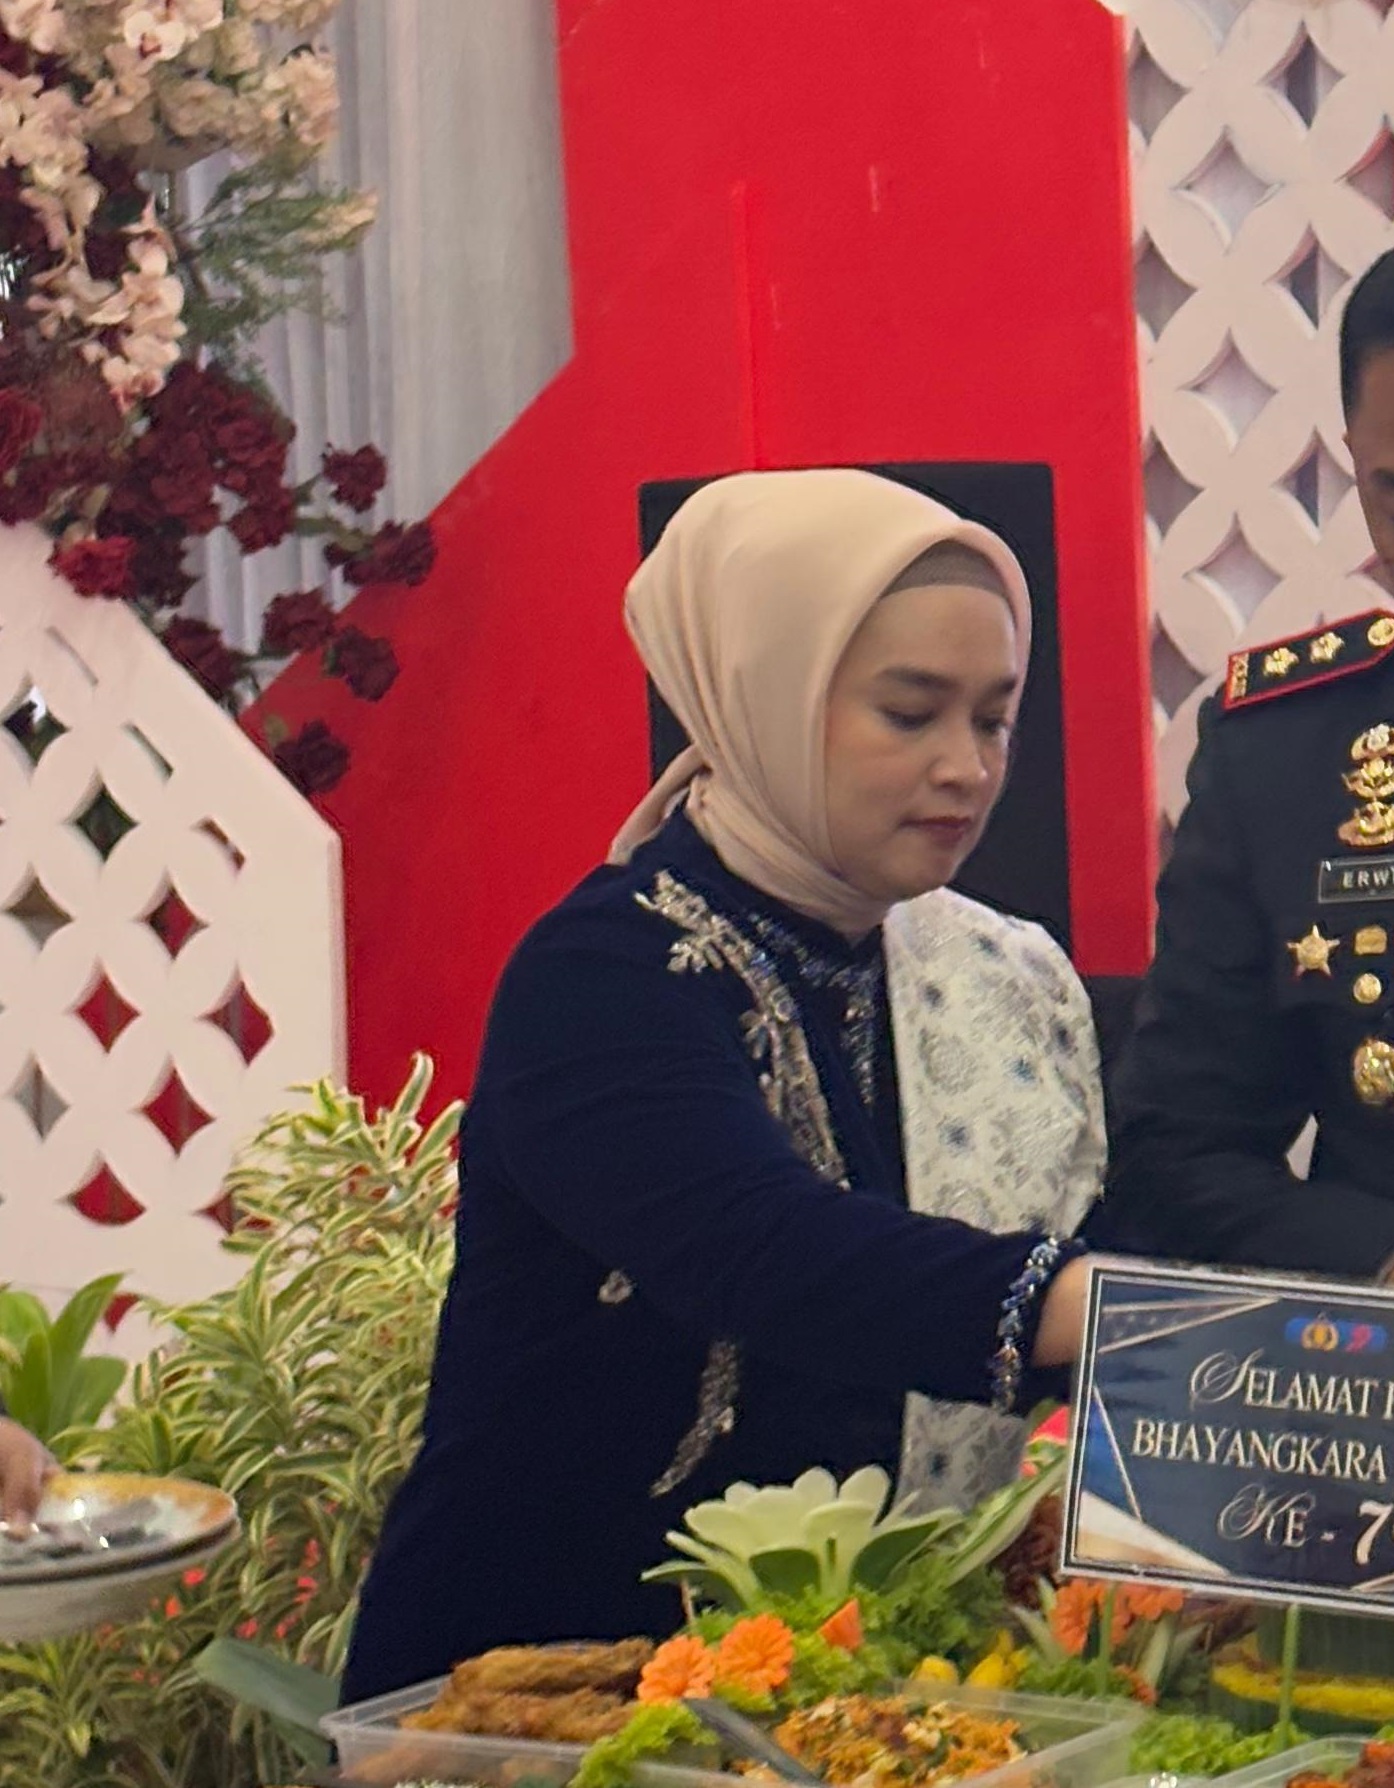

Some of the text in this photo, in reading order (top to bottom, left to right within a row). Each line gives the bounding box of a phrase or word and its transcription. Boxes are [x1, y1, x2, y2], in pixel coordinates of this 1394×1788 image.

[1190, 1348, 1379, 1418] SELAMAT
[1131, 1419, 1387, 1484] BHAYANGKARA
[1216, 1483, 1317, 1548] KE
